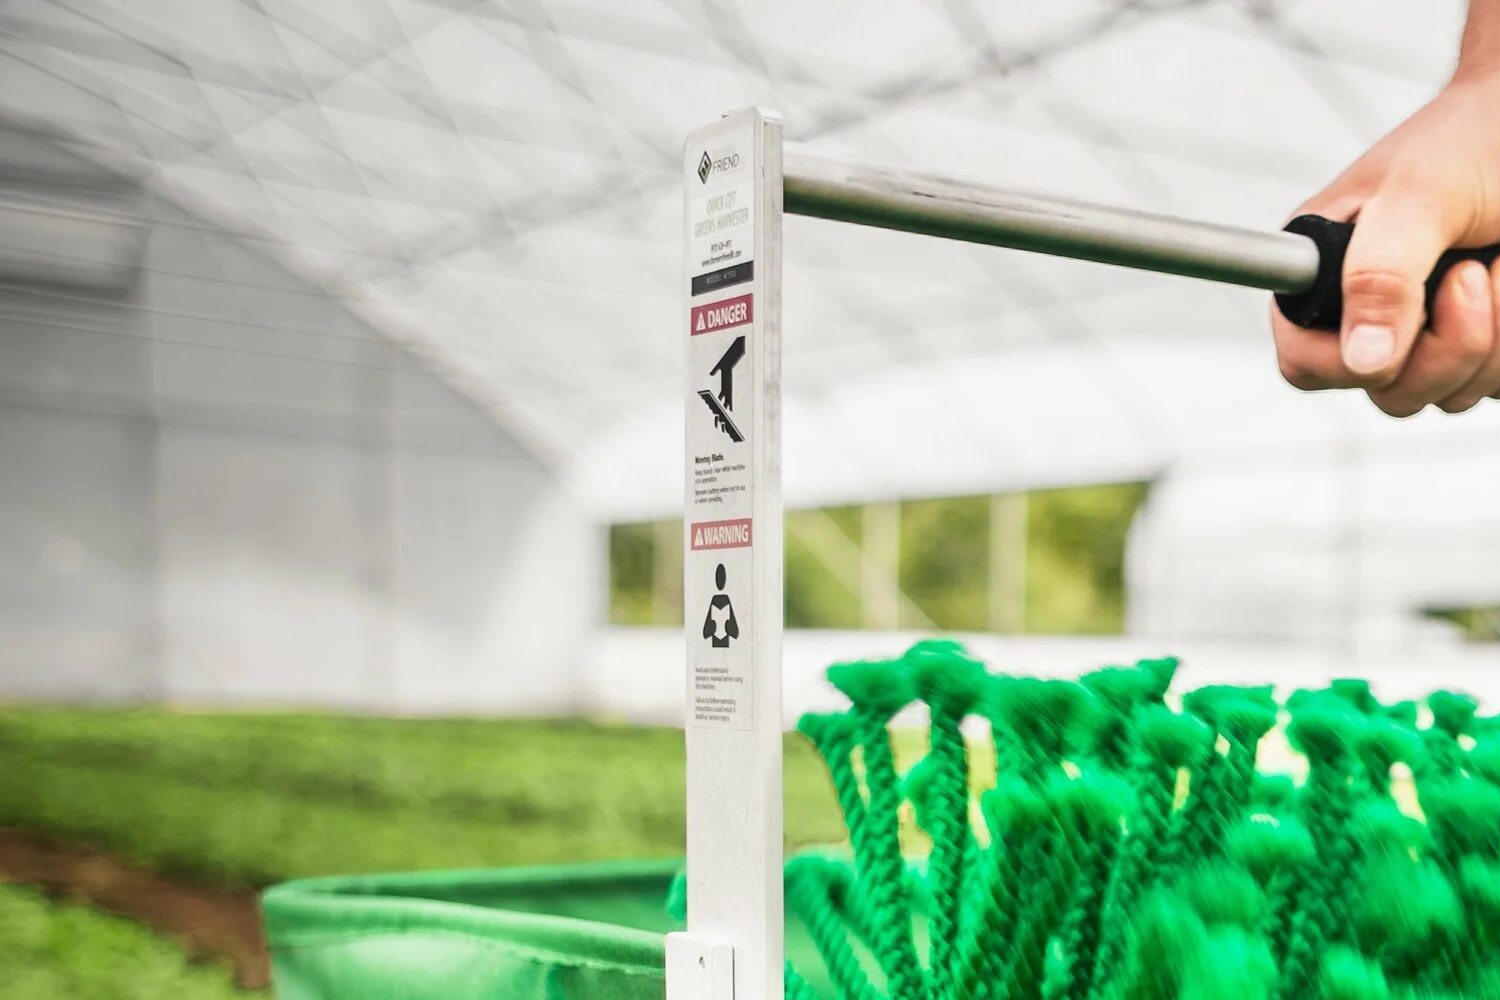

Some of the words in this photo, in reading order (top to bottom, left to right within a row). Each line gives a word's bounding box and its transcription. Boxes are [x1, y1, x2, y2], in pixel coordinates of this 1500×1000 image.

[711, 153, 739, 175] FRIEND
[707, 302, 748, 329] DANGER
[703, 524, 749, 545] WARNING
